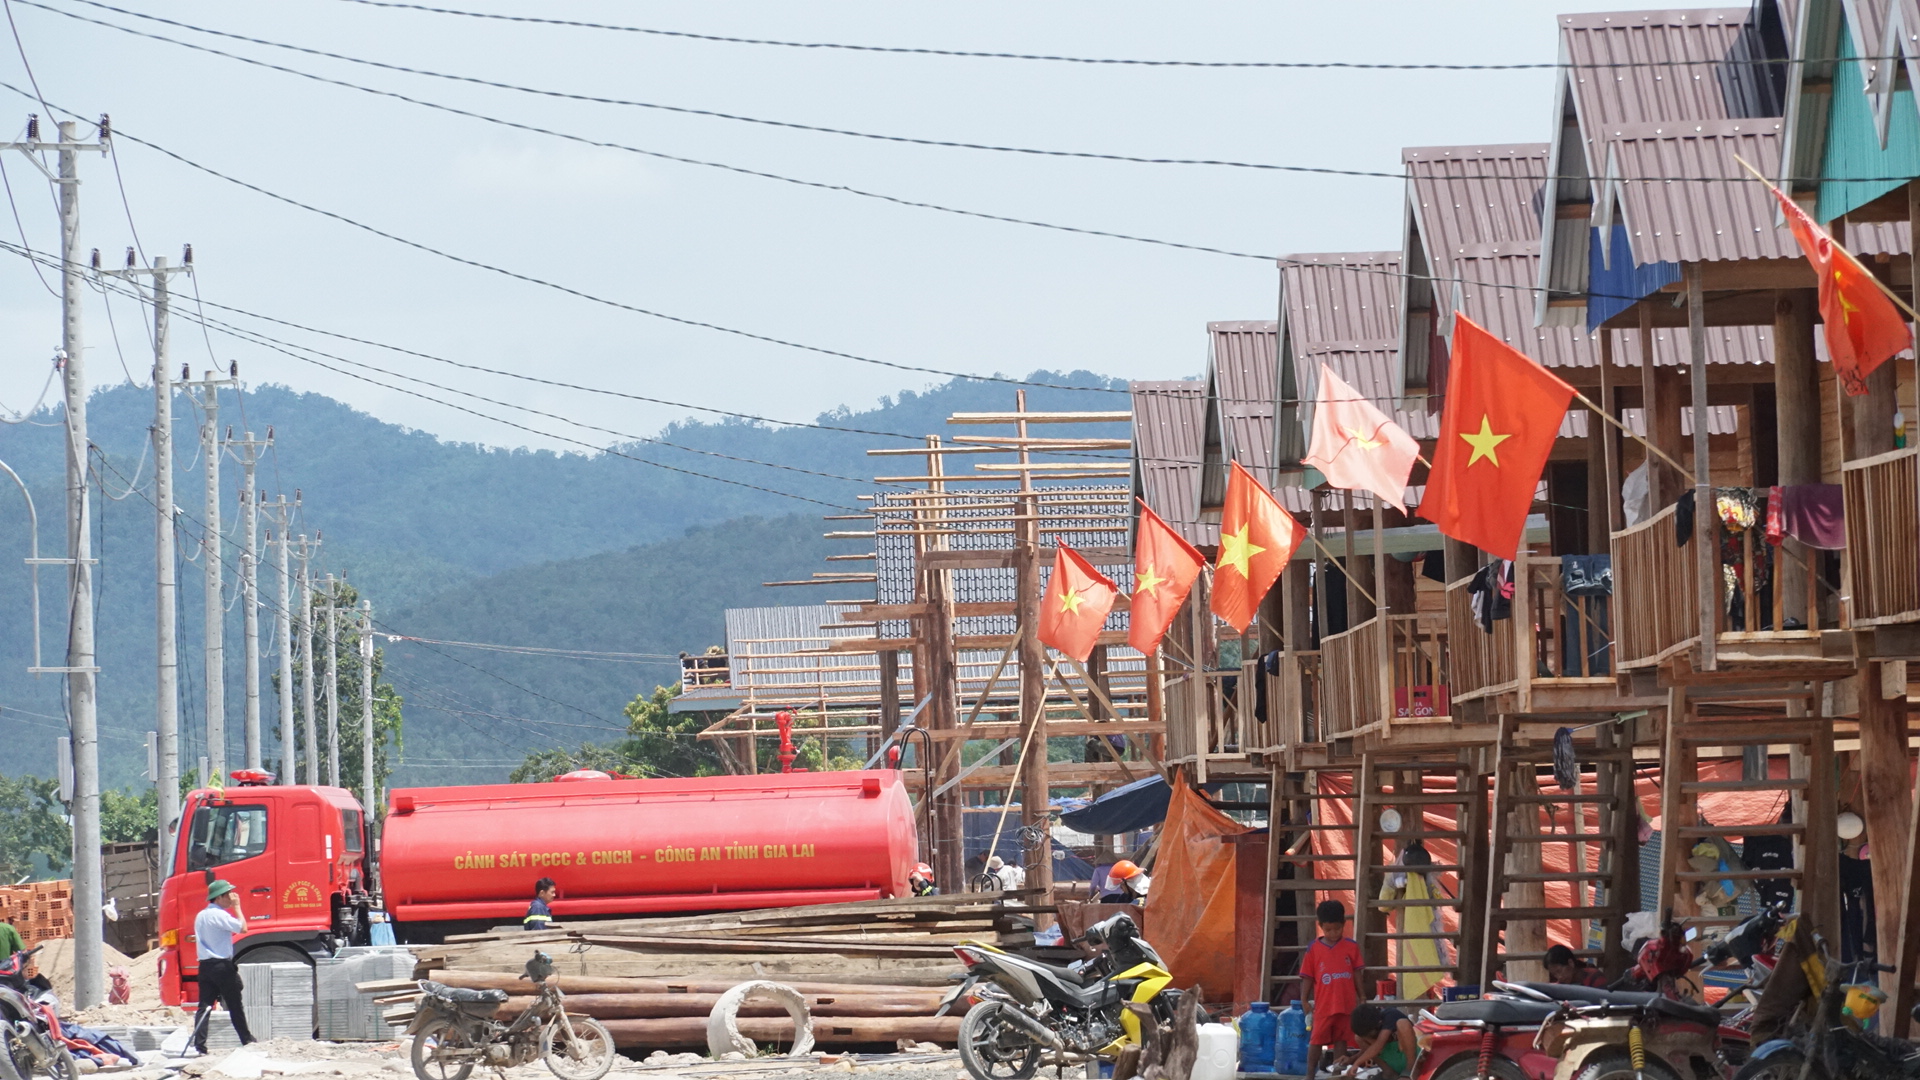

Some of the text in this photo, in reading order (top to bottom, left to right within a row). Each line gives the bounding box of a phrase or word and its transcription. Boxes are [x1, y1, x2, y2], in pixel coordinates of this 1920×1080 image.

[1398, 707, 1434, 717] SAGON
[454, 850, 496, 870] CẢNH
[499, 850, 528, 868] SÁT
[531, 852, 572, 867] PCCC
[575, 851, 587, 866] &
[591, 849, 633, 865] CNCH
[654, 845, 696, 863] CÔNG
[700, 846, 721, 861] AN
[724, 841, 759, 860] TỈNH
[763, 844, 789, 859] GIA
[792, 843, 816, 858] LAI
